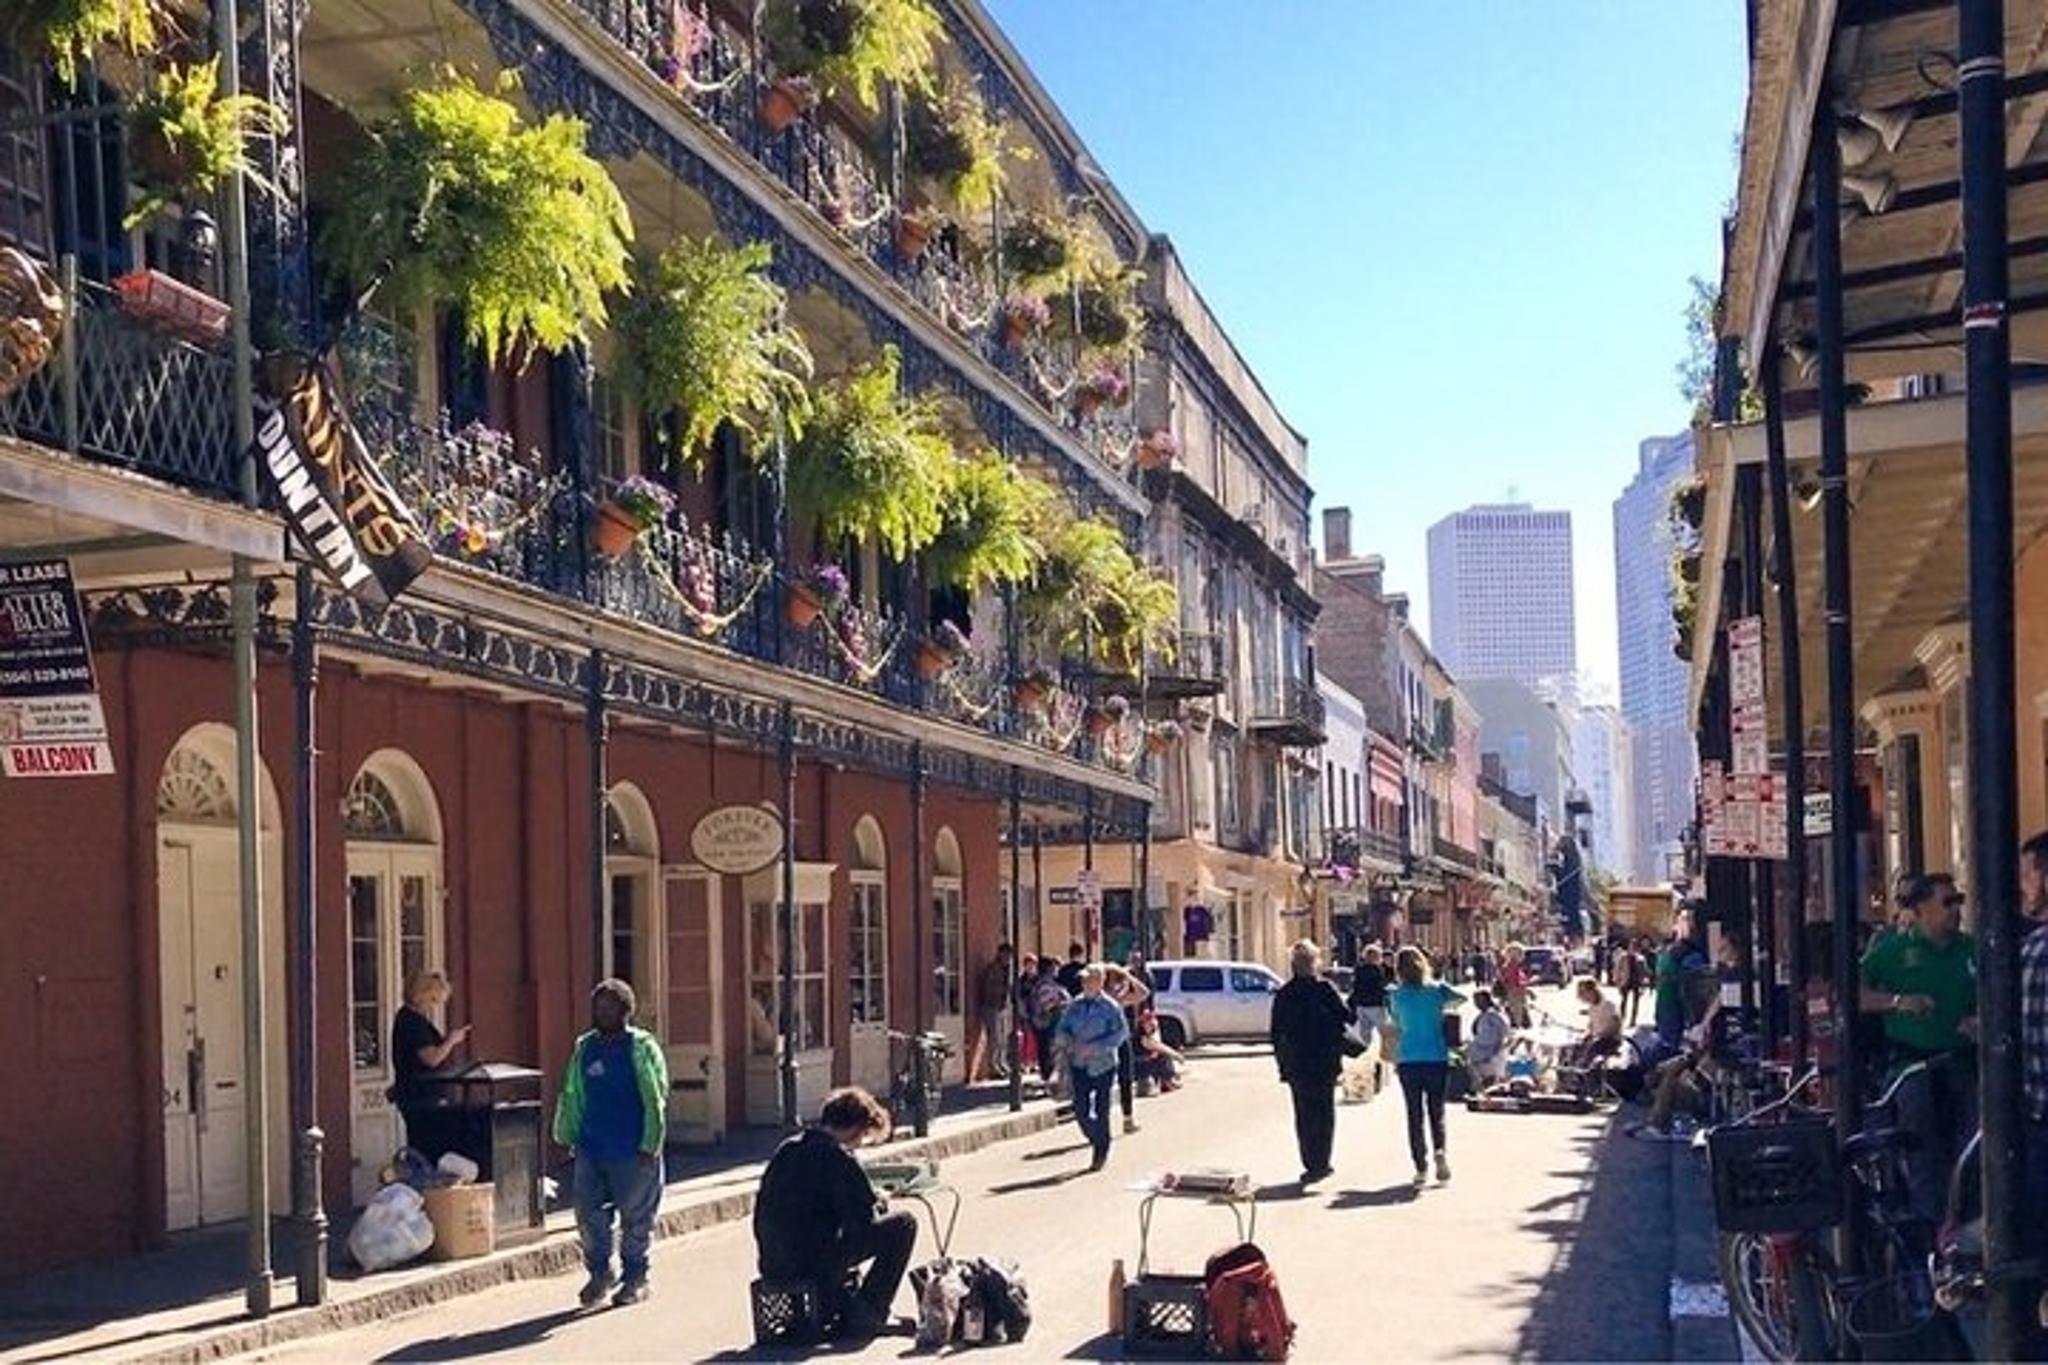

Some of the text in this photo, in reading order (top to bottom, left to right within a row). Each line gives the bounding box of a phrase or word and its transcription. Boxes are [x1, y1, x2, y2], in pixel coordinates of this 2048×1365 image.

[291, 366, 408, 556] AINTS
[257, 408, 373, 590] OUNTRY
[12, 563, 67, 582] LEASE
[0, 590, 66, 615] ATTER
[12, 608, 71, 633] BLUM
[11, 744, 98, 773] BALCONY
